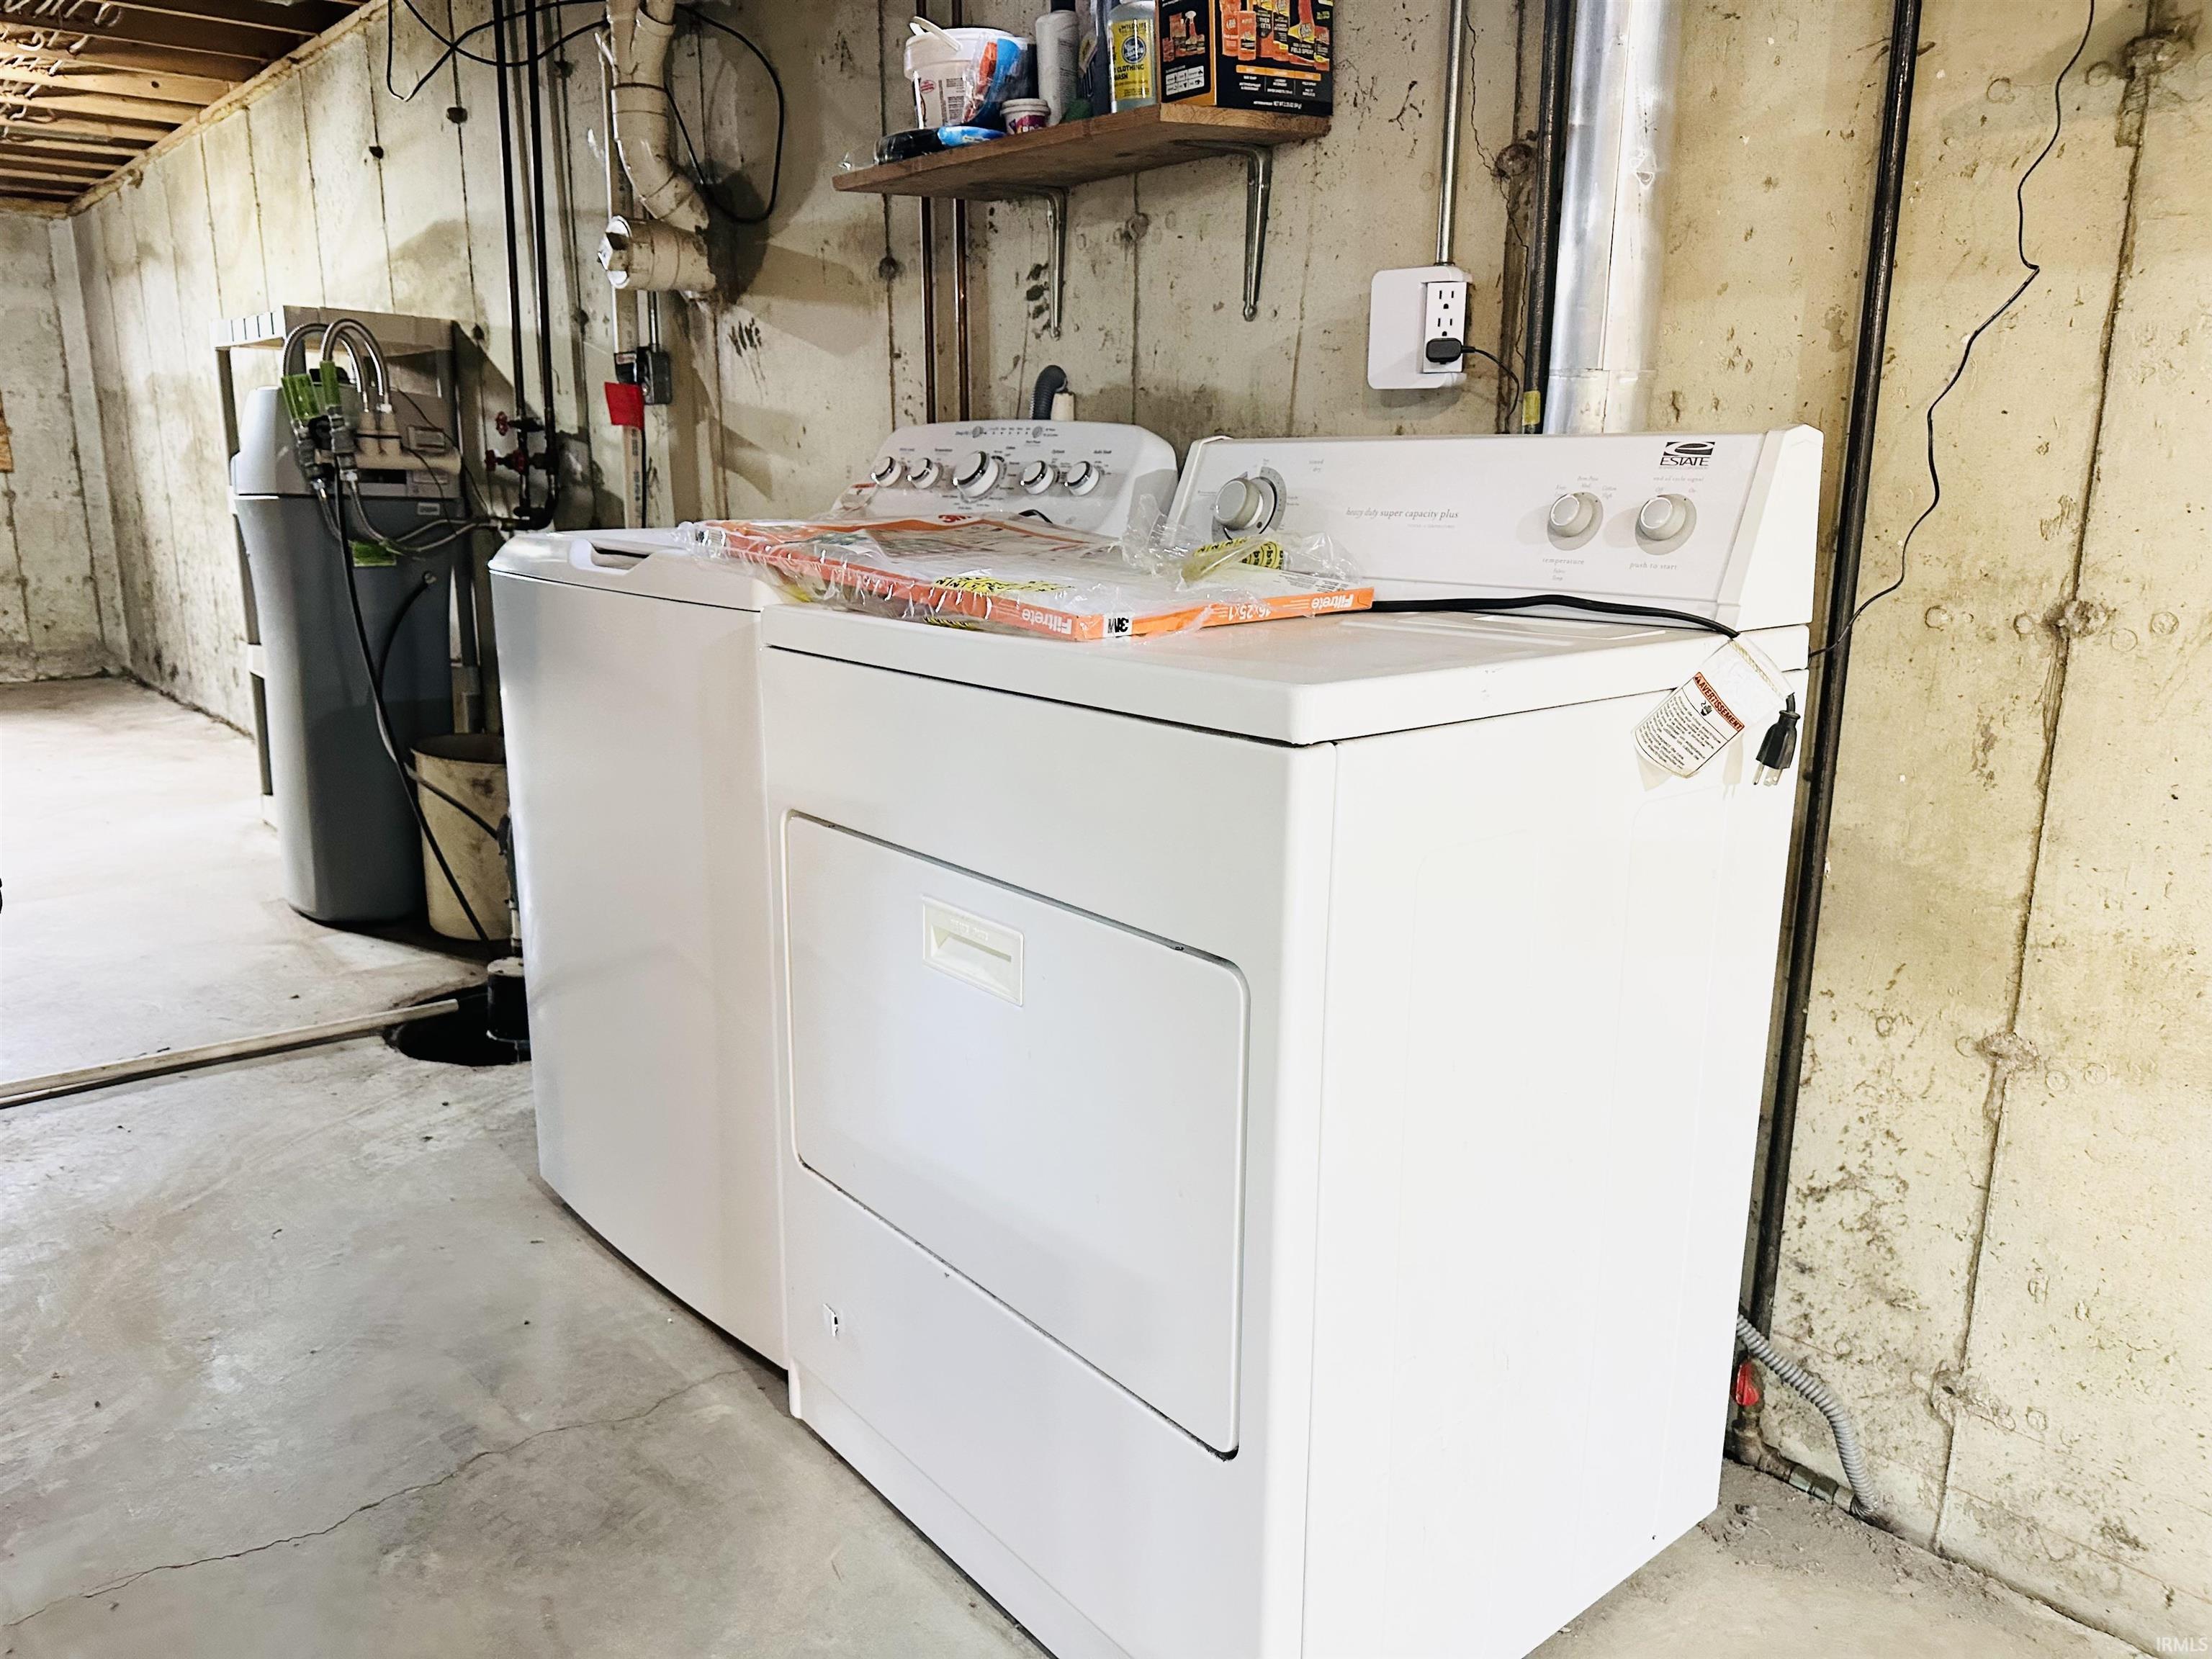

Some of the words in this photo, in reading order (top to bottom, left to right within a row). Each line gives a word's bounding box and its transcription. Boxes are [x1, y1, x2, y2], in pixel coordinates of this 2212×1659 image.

[1117, 63, 1145, 73] CLOTHING
[1660, 457, 1711, 467] ESTATE
[1380, 510, 1403, 520] super
[1405, 509, 1439, 520] capacity
[1439, 508, 1459, 521] plus
[1311, 593, 1354, 609] Filtrete
[1021, 608, 1072, 635] Filtrete
[1699, 681, 1743, 730] AVERTISSEMENT
